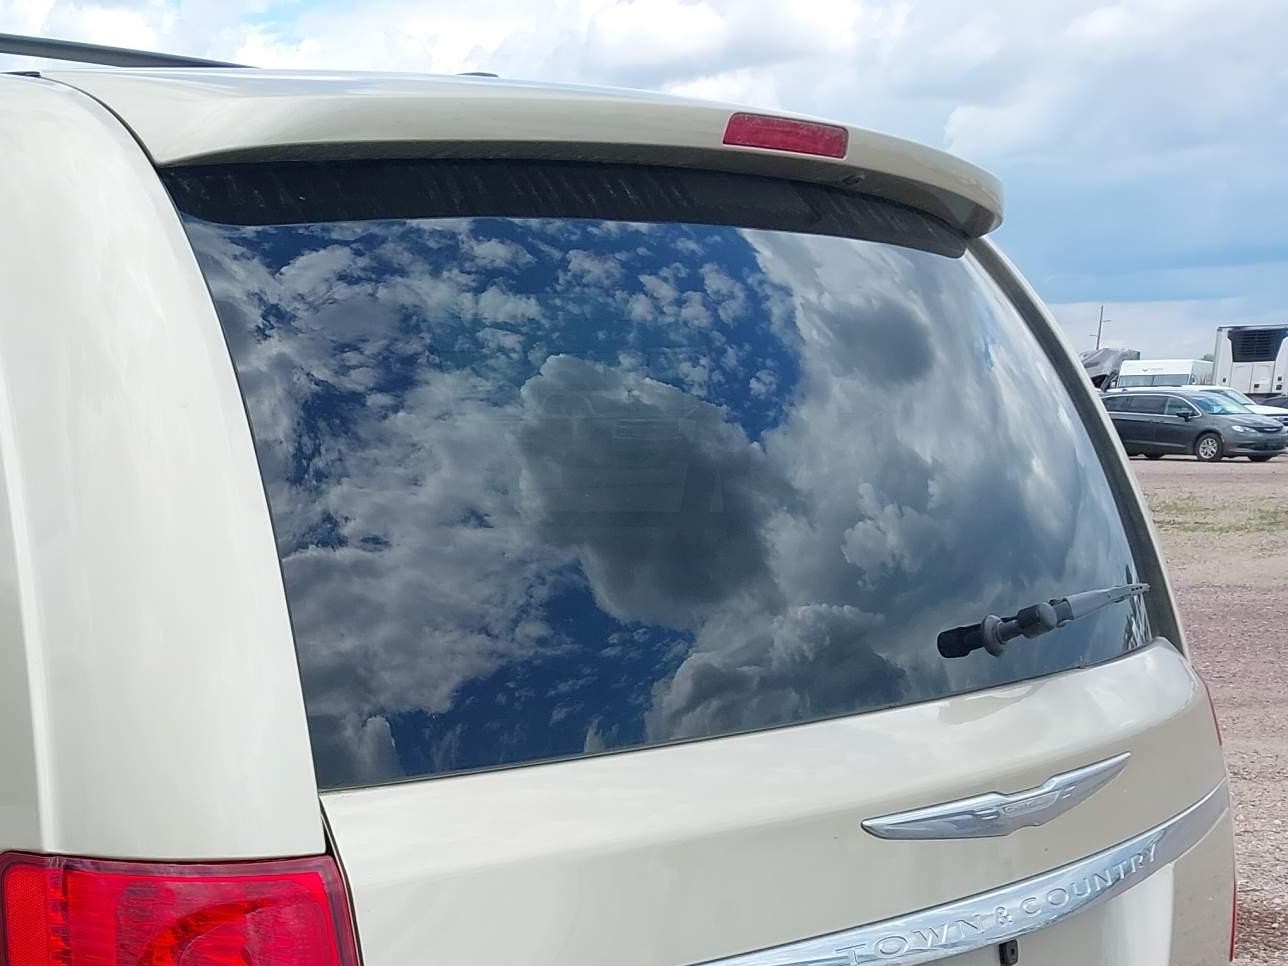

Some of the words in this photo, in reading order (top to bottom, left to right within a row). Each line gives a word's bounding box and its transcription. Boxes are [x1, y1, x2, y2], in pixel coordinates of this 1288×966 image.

[835, 913, 986, 966] TOWN
[992, 905, 1014, 927] &
[1020, 842, 1158, 918] COUNTRY
